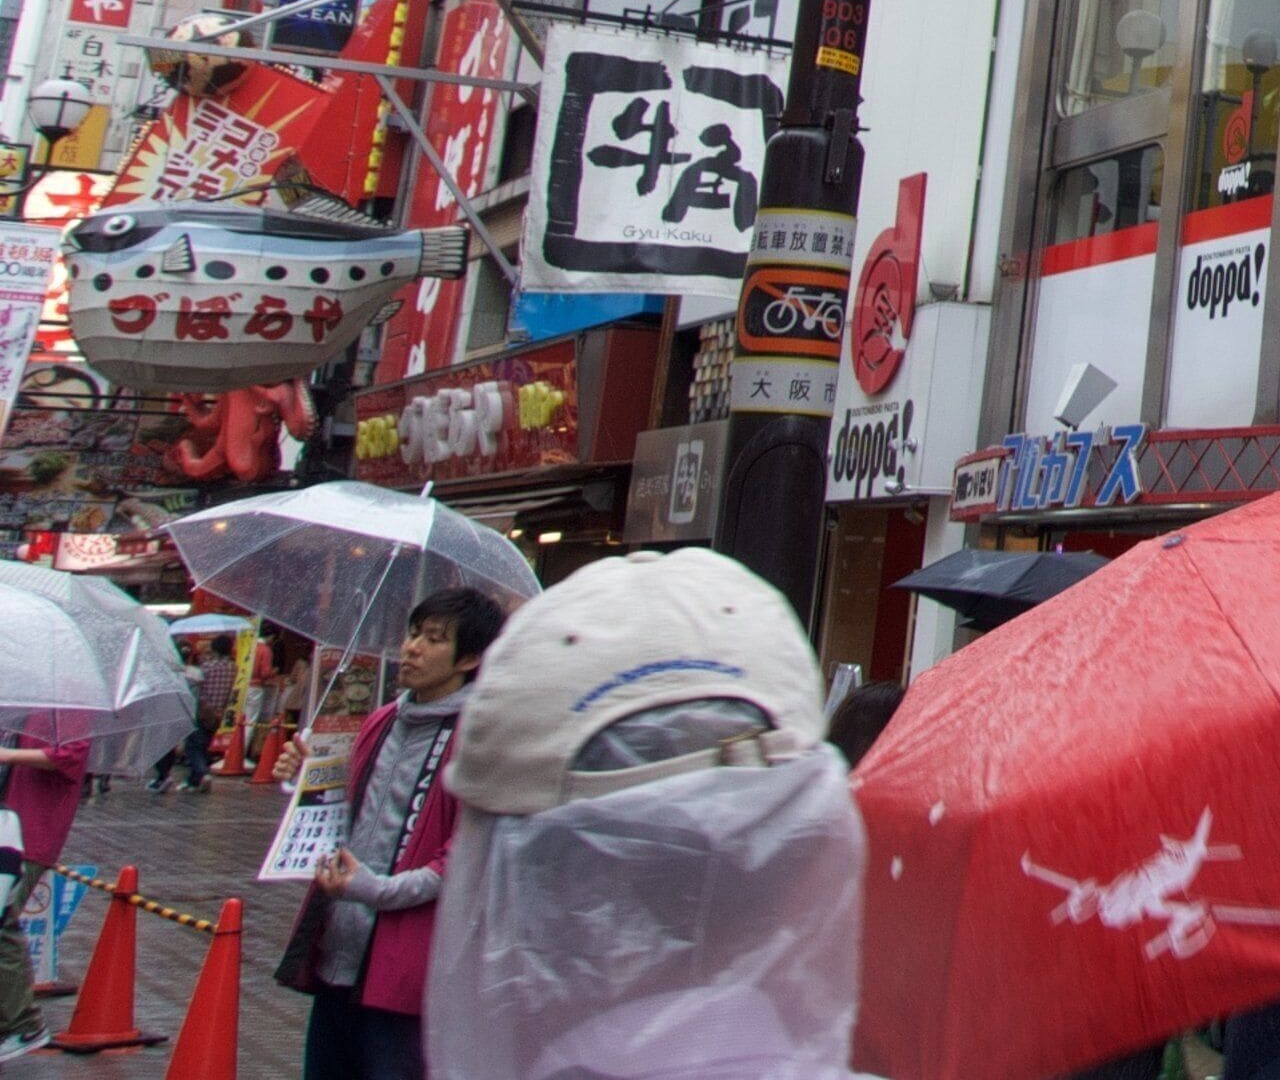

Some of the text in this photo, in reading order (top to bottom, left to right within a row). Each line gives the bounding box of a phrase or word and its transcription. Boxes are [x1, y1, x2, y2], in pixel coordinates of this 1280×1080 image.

[586, 96, 758, 231] 牛角
[622, 223, 713, 244] Gyu-Kaku
[108, 290, 345, 343] づぼらや
[1186, 242, 1265, 320] doppa!
[833, 398, 914, 499] doppa!
